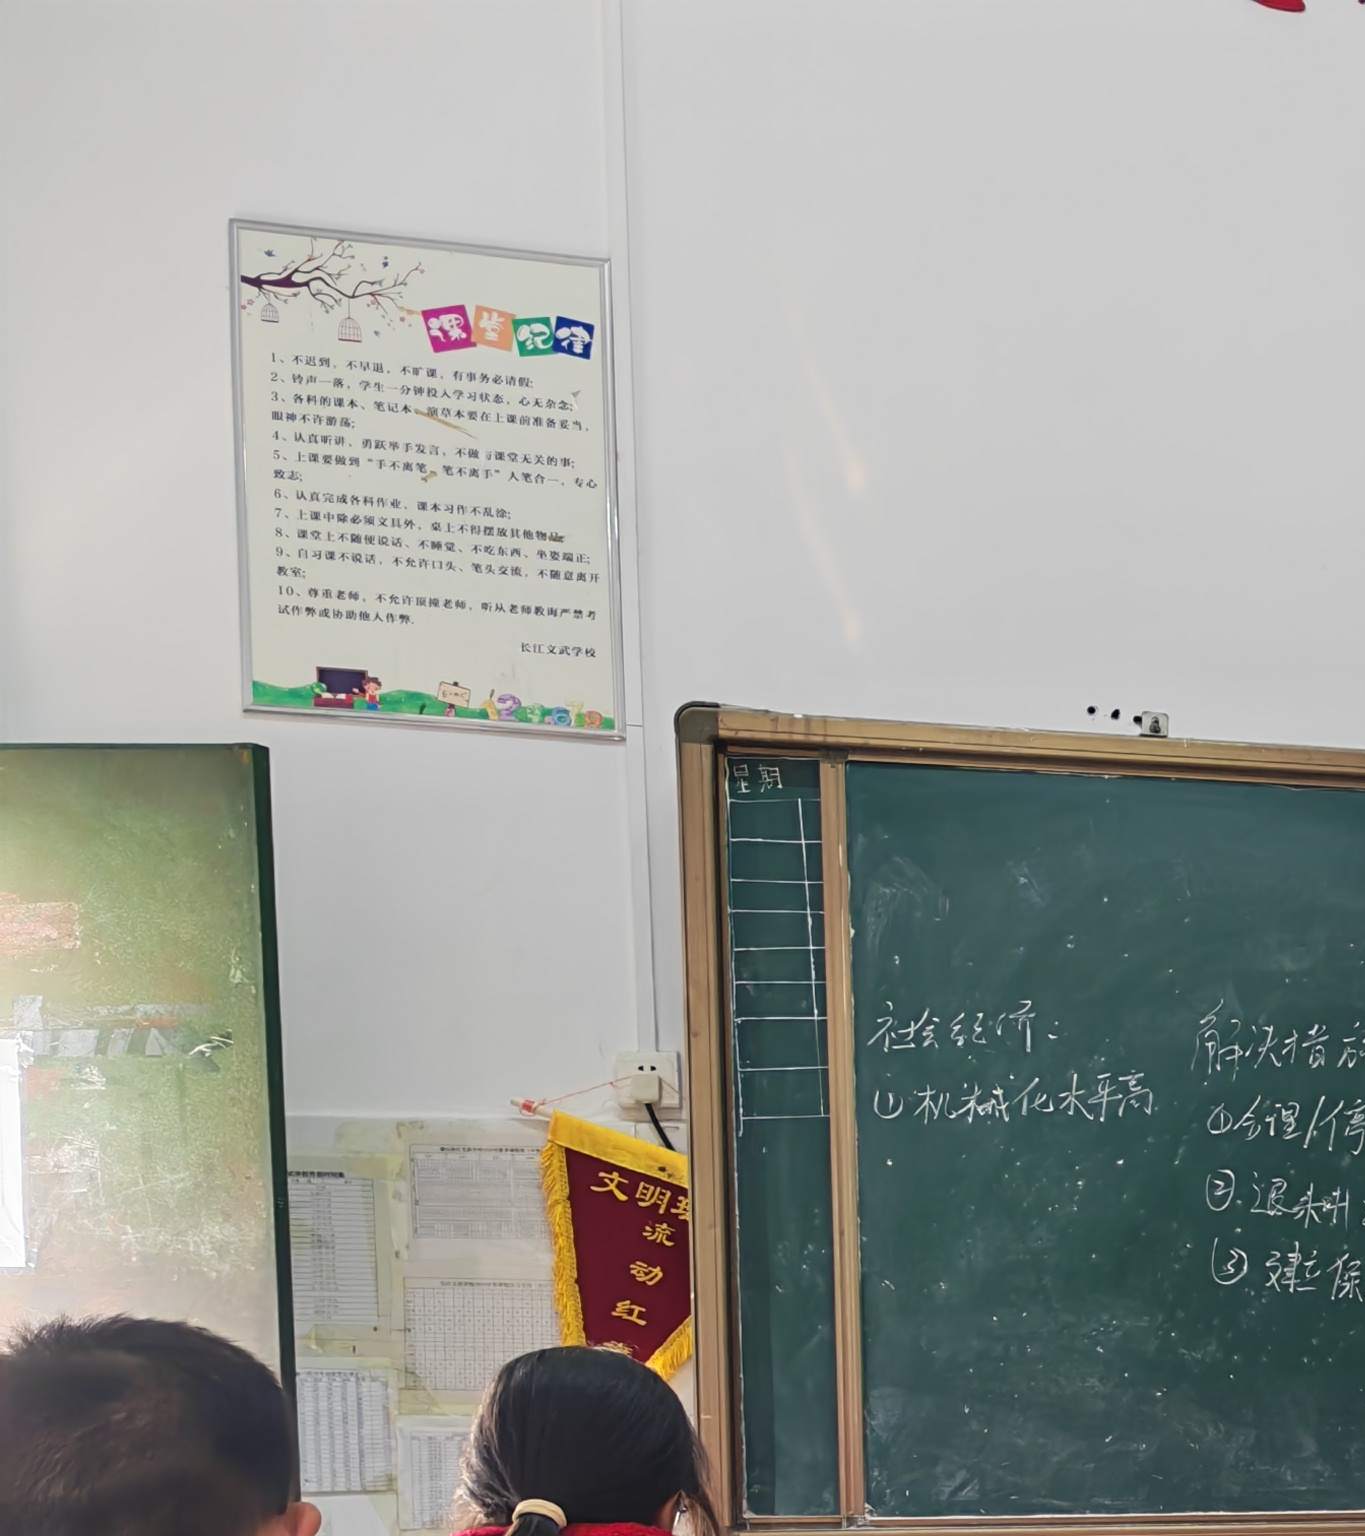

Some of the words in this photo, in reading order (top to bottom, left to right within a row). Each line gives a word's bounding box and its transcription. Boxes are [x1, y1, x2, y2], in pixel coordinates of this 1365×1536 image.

[428, 311, 592, 354] 课堂纪律
[521, 642, 596, 658] 长江文武学校
[733, 764, 783, 793] 星期
